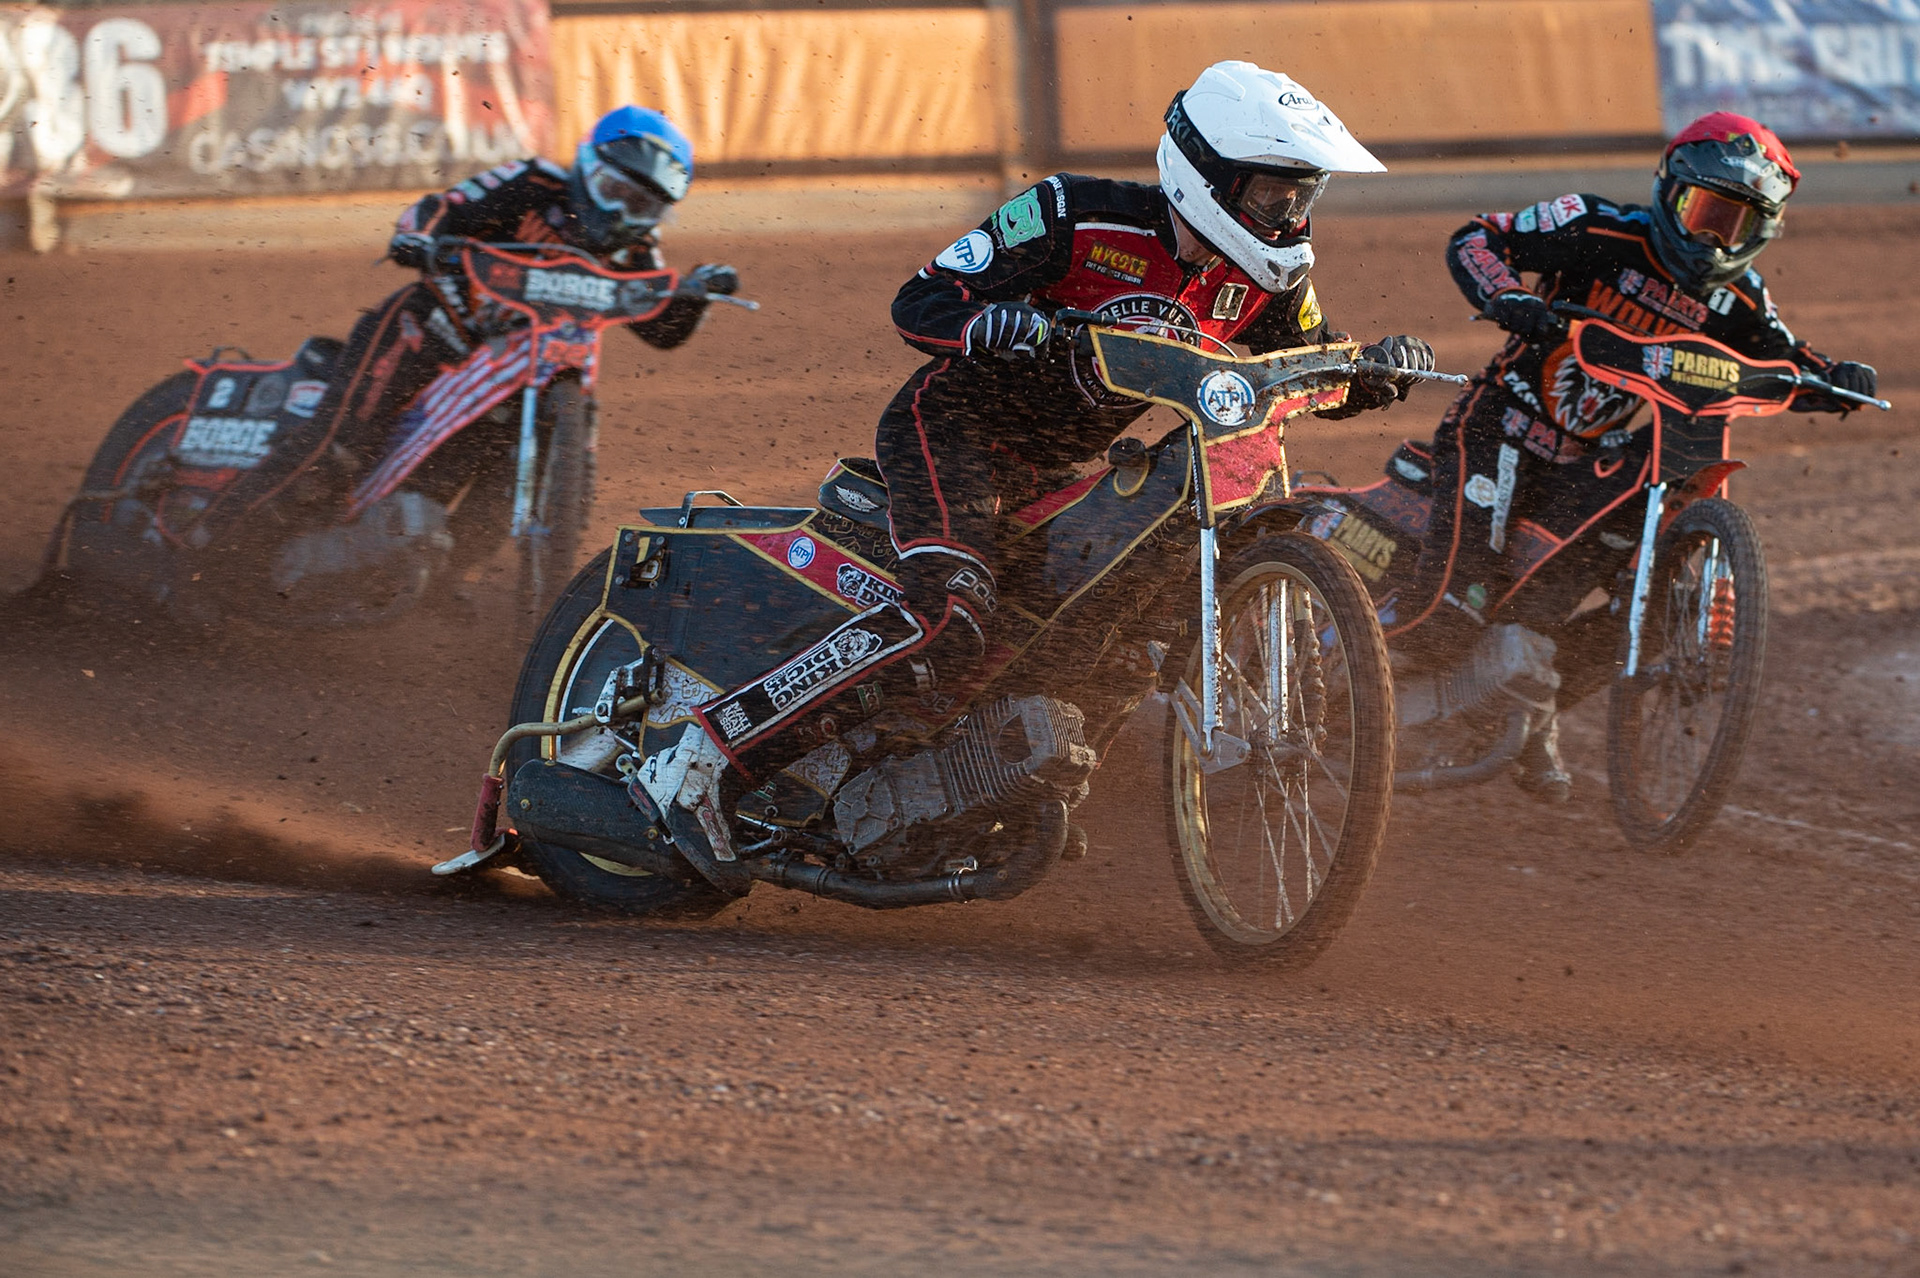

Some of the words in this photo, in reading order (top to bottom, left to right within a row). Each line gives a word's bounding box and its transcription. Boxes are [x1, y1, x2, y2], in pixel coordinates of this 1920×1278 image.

[953, 237, 977, 267] ATPI
[1585, 279, 1706, 337] WOLV
[1674, 350, 1740, 383] PARRYS
[1207, 389, 1247, 408] ATPI
[791, 543, 812, 562] ATPI
[865, 576, 902, 603] KIN
[767, 647, 835, 697] DICK
[774, 658, 842, 709] KING
